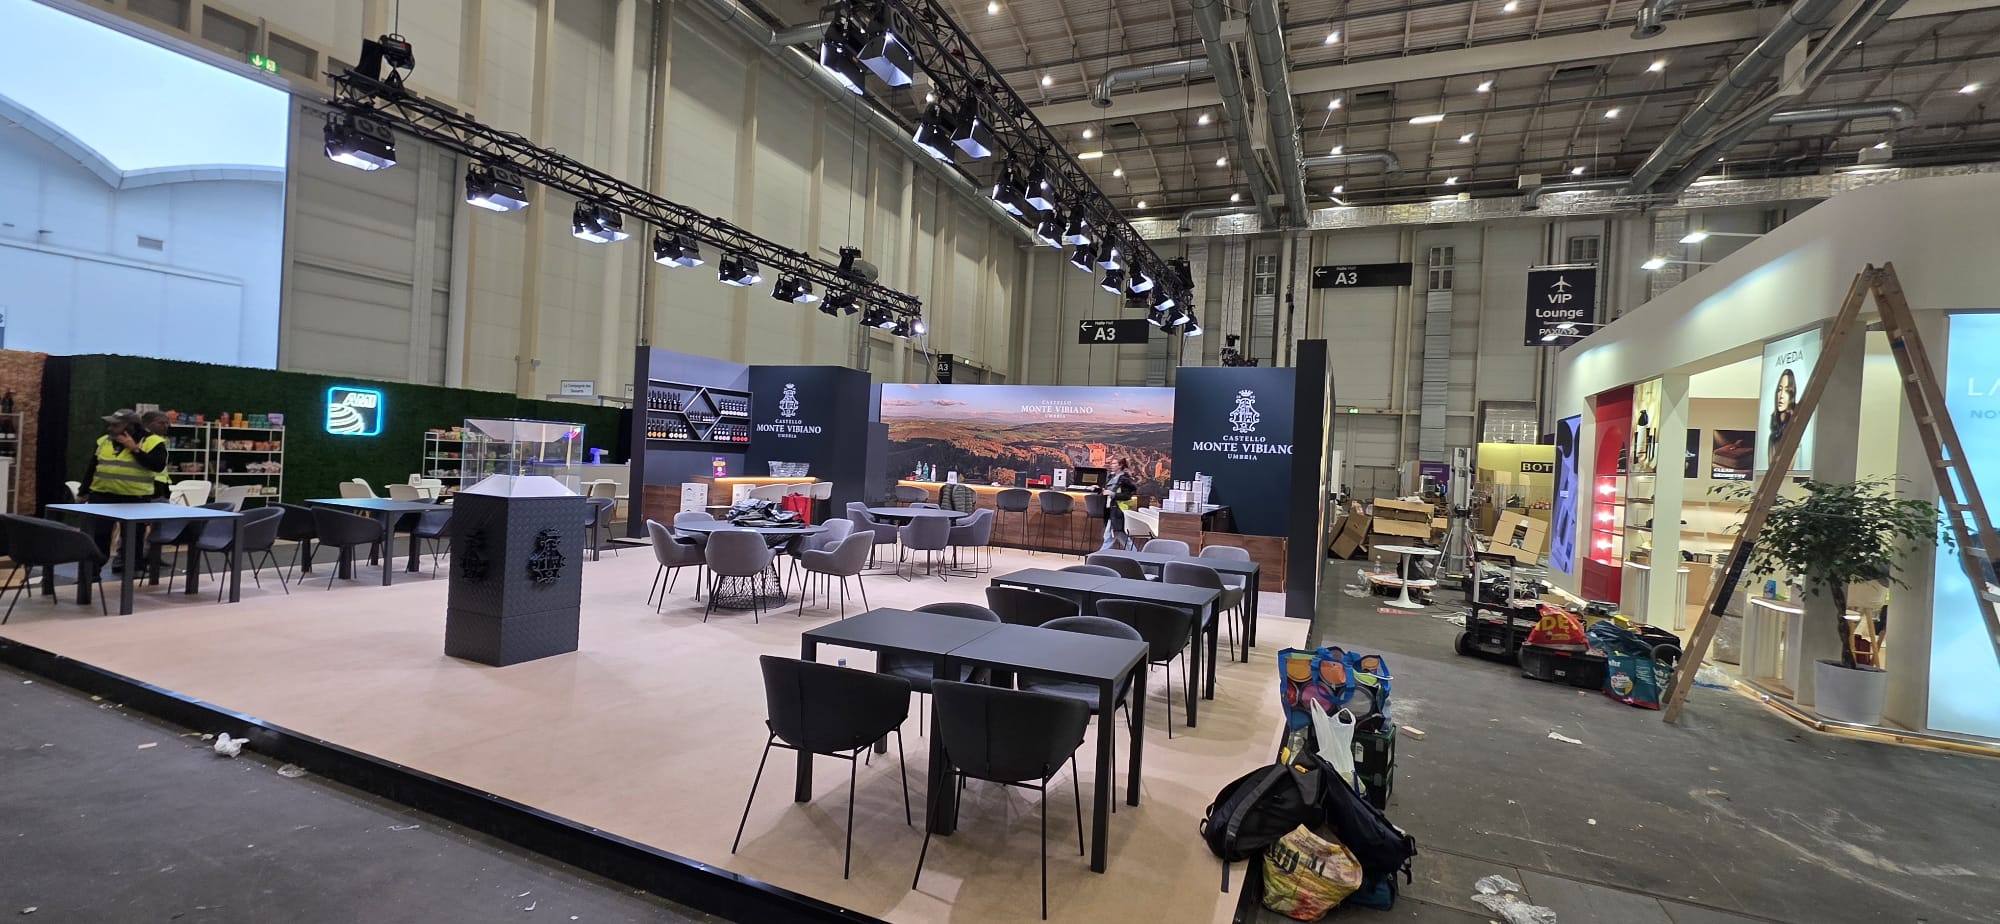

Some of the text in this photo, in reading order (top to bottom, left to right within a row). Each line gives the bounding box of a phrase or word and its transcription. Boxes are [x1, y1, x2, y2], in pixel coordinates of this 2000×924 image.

[1335, 272, 1358, 285] A3
[1547, 293, 1573, 304] VIP
[1535, 308, 1584, 319] Lounge
[1094, 327, 1116, 341] A3
[1775, 349, 1804, 367] AVEDA
[937, 363, 949, 371] A3
[1021, 405, 1093, 414] MONTE VIBIANO
[1969, 409, 2000, 419] NO
[756, 424, 822, 434] MONTE VIBIANO
[1223, 435, 1266, 443] CASTELLO
[1192, 441, 1238, 452] MONTE
[1227, 453, 1258, 461] UMBRIA
[1522, 463, 1552, 472] BOT
